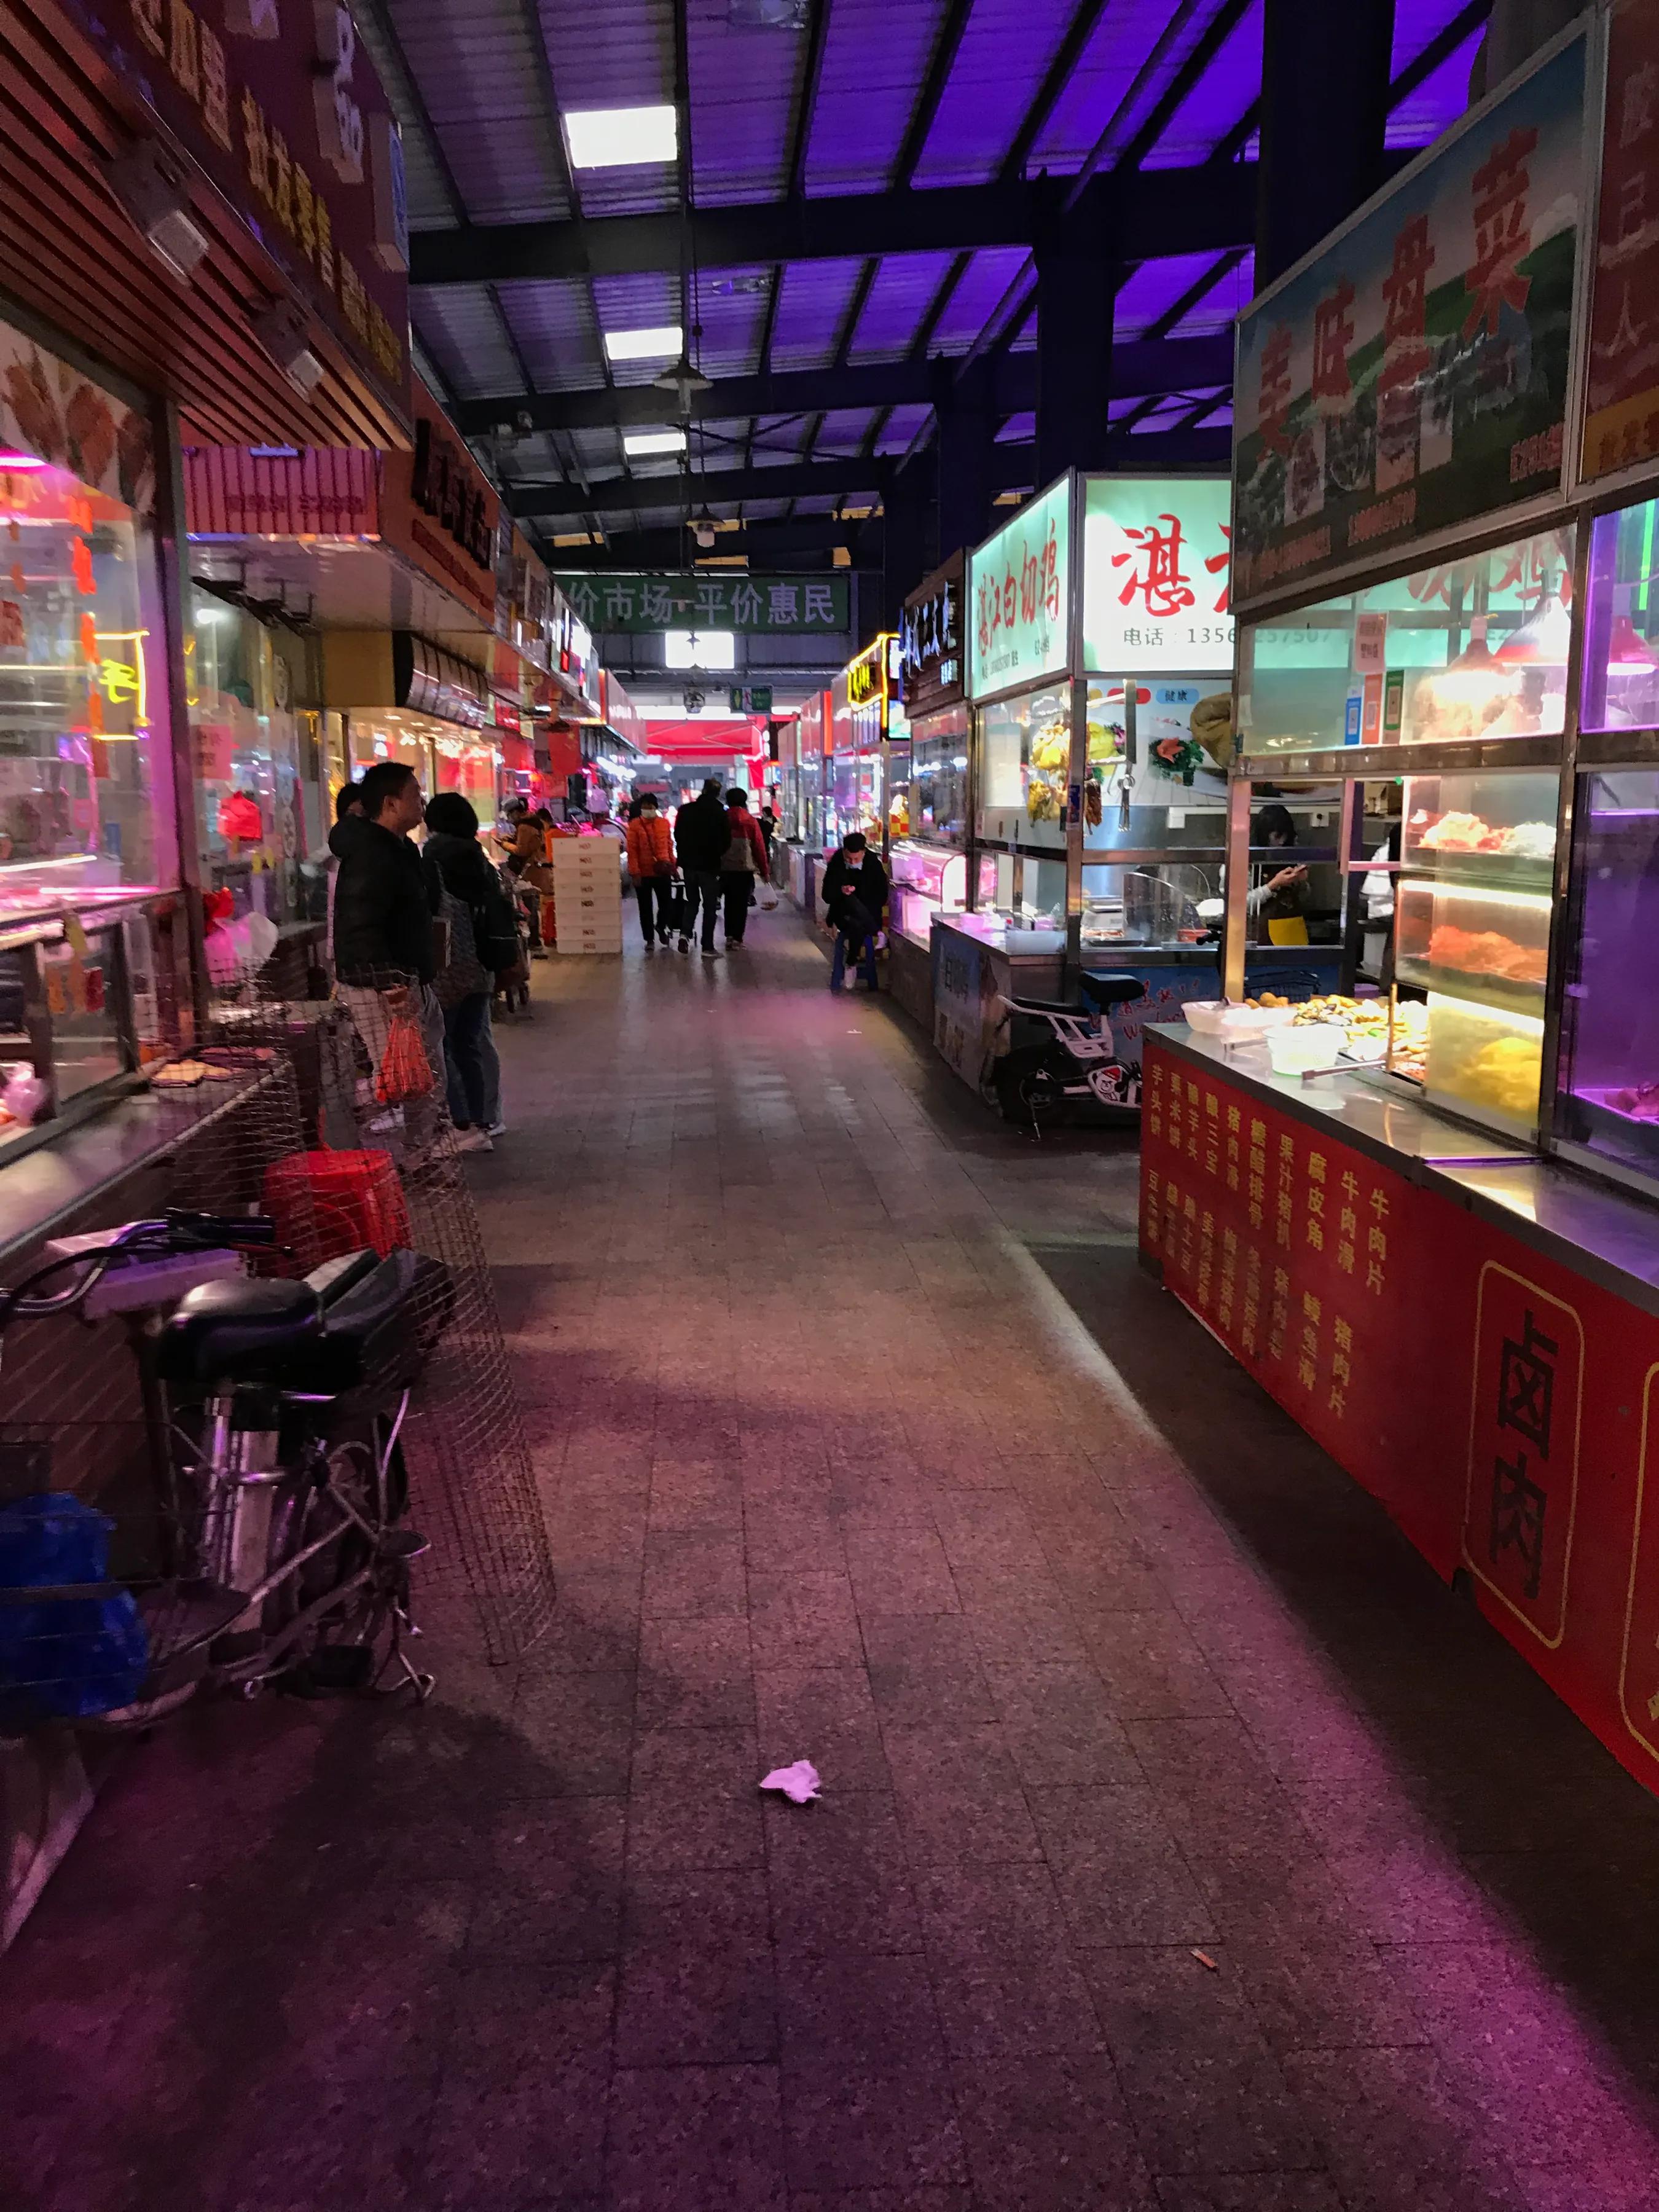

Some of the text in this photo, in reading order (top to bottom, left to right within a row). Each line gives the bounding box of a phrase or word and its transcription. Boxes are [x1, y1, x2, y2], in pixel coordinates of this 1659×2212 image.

[694, 582, 834, 624] 平价惠民
[978, 517, 1060, 657] 湛江白切鸡
[1165, 690, 1187, 702] 健康
[1249, 1118, 1266, 1230] 糖醋排骨
[1276, 1134, 1294, 1251] 果汁猪扒
[1366, 1188, 1390, 1296] 牛肉片
[1328, 1314, 1353, 1419] 猪肉片
[1489, 1308, 1559, 1599] 卤肉
